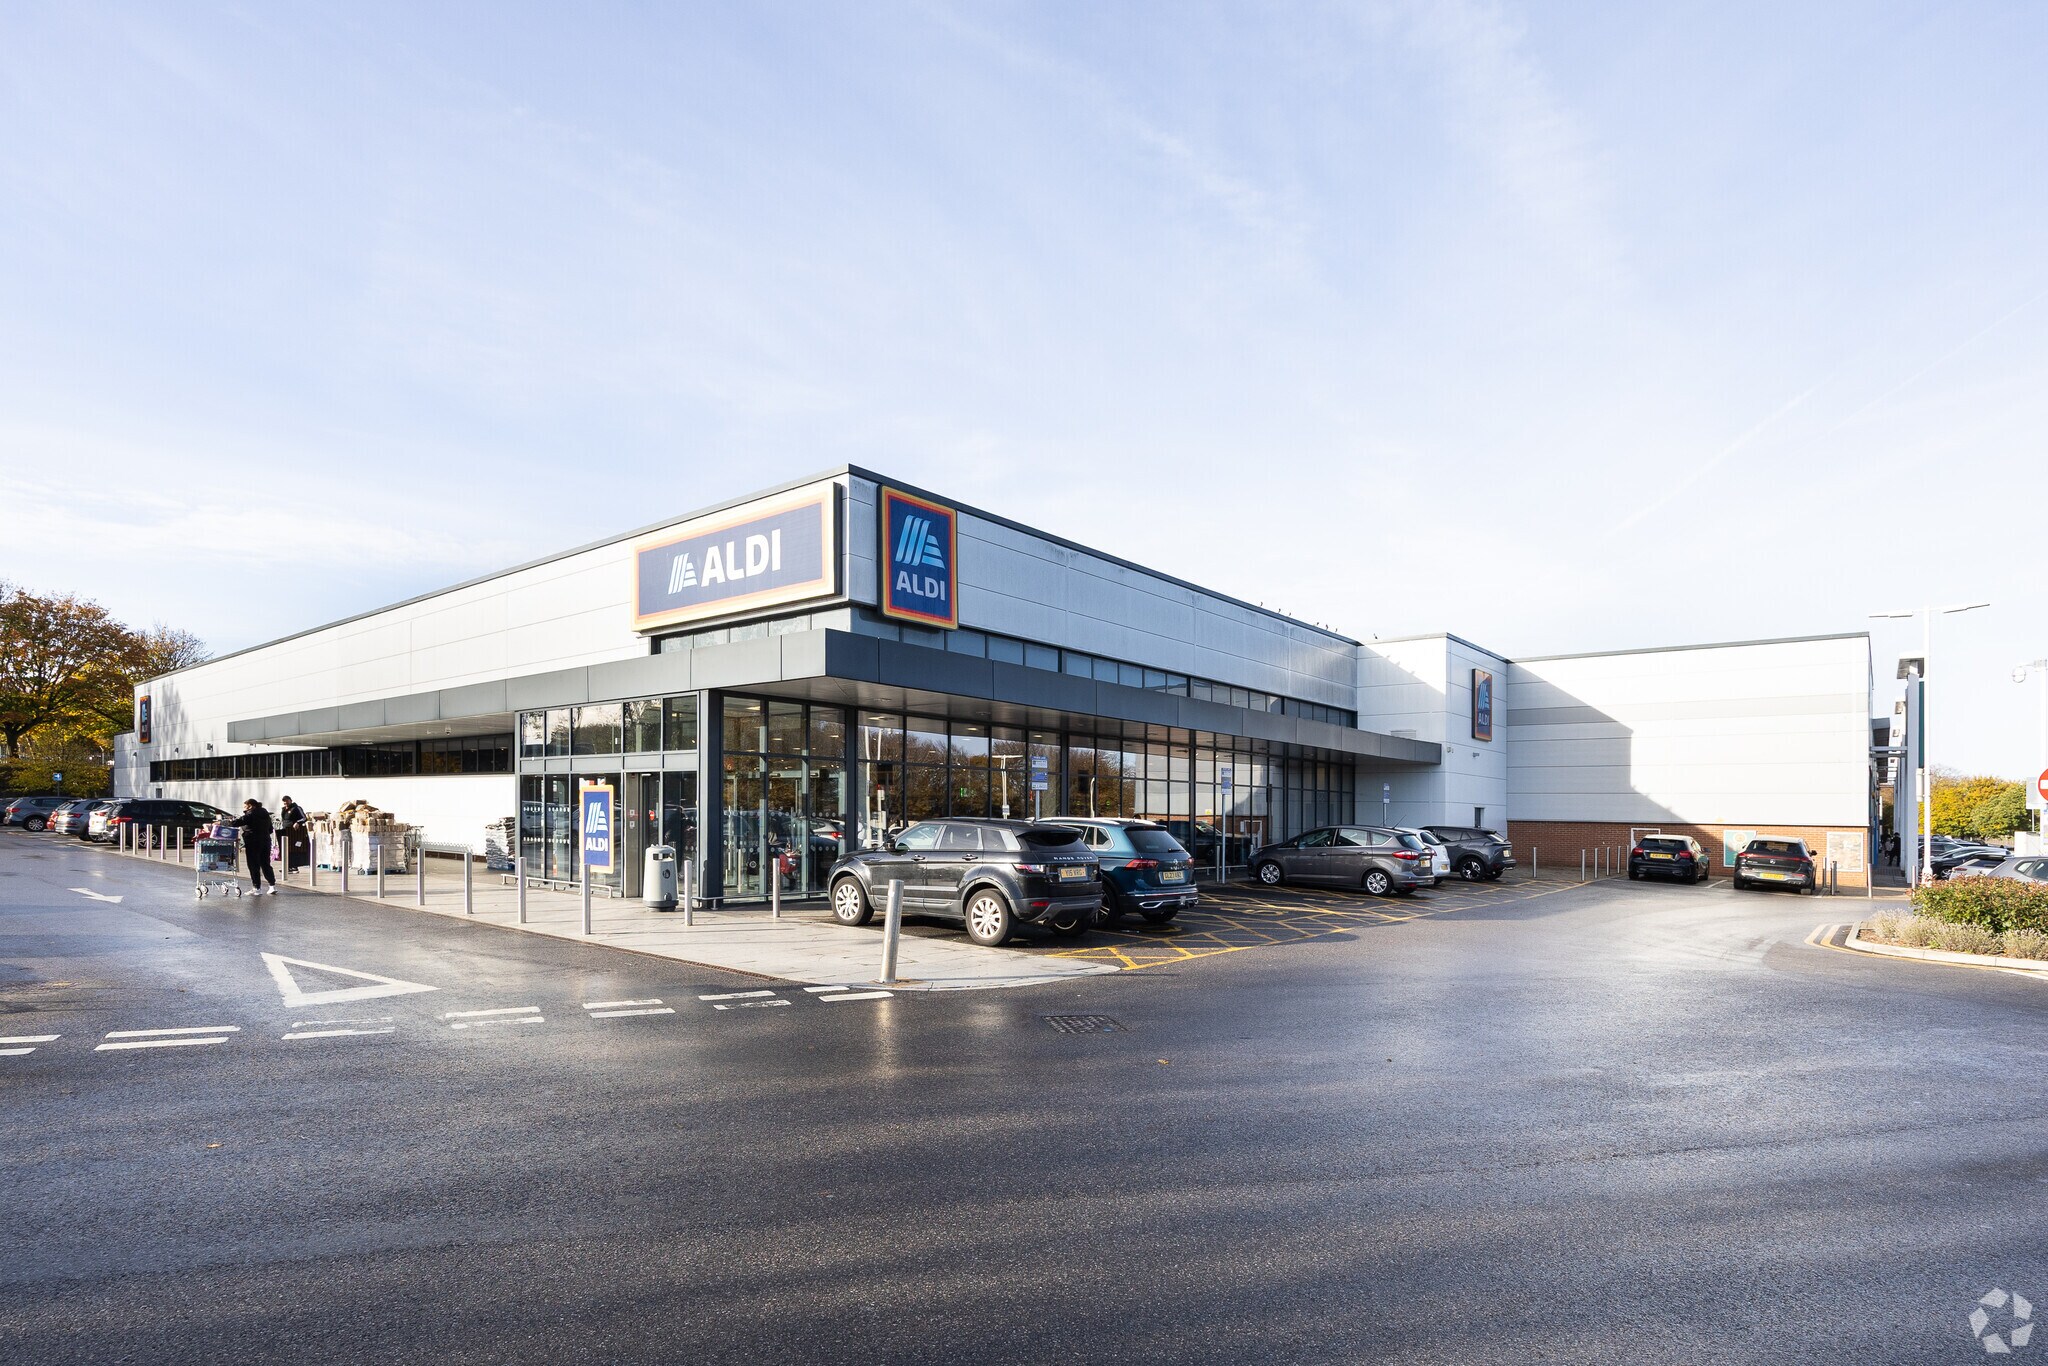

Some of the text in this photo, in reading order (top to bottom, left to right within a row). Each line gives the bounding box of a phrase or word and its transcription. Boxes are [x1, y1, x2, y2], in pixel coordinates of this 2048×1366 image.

[701, 528, 781, 588] ALDI
[896, 570, 946, 601] ALDI
[1477, 712, 1490, 726] ALDI
[585, 837, 608, 851] ALDI
